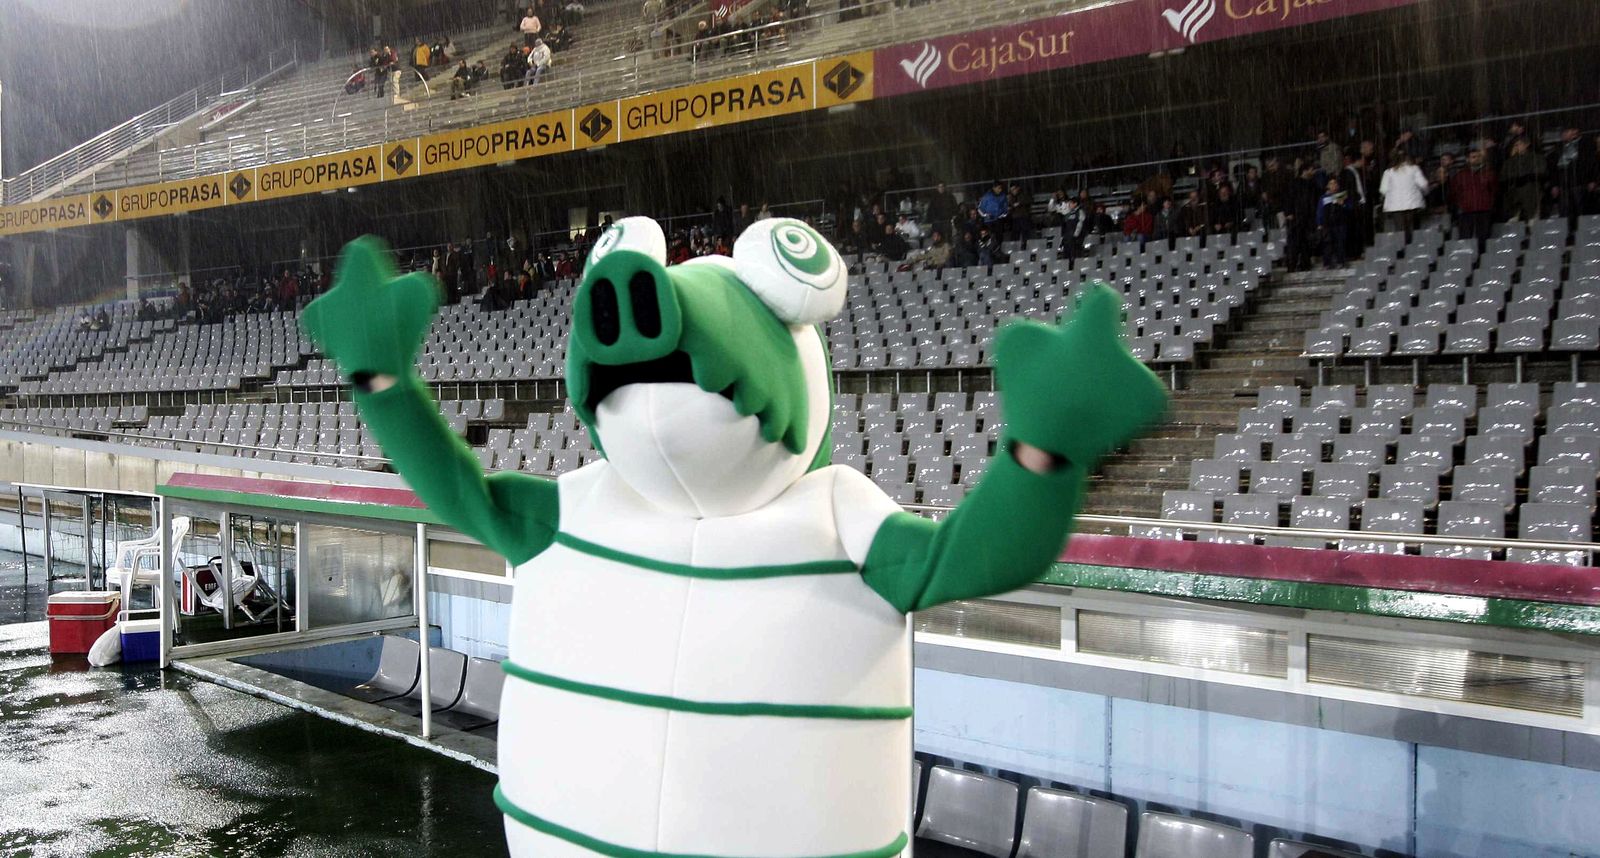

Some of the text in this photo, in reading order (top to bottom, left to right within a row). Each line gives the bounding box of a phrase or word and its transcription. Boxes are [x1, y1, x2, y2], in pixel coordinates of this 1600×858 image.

[947, 30, 1074, 75] CajaSur
[626, 77, 805, 130] GRUPOPRASA
[424, 122, 567, 165] GRUPOPRASA
[261, 156, 376, 192] GRUPOPRASA
[121, 182, 221, 212] GRUPOPRASA
